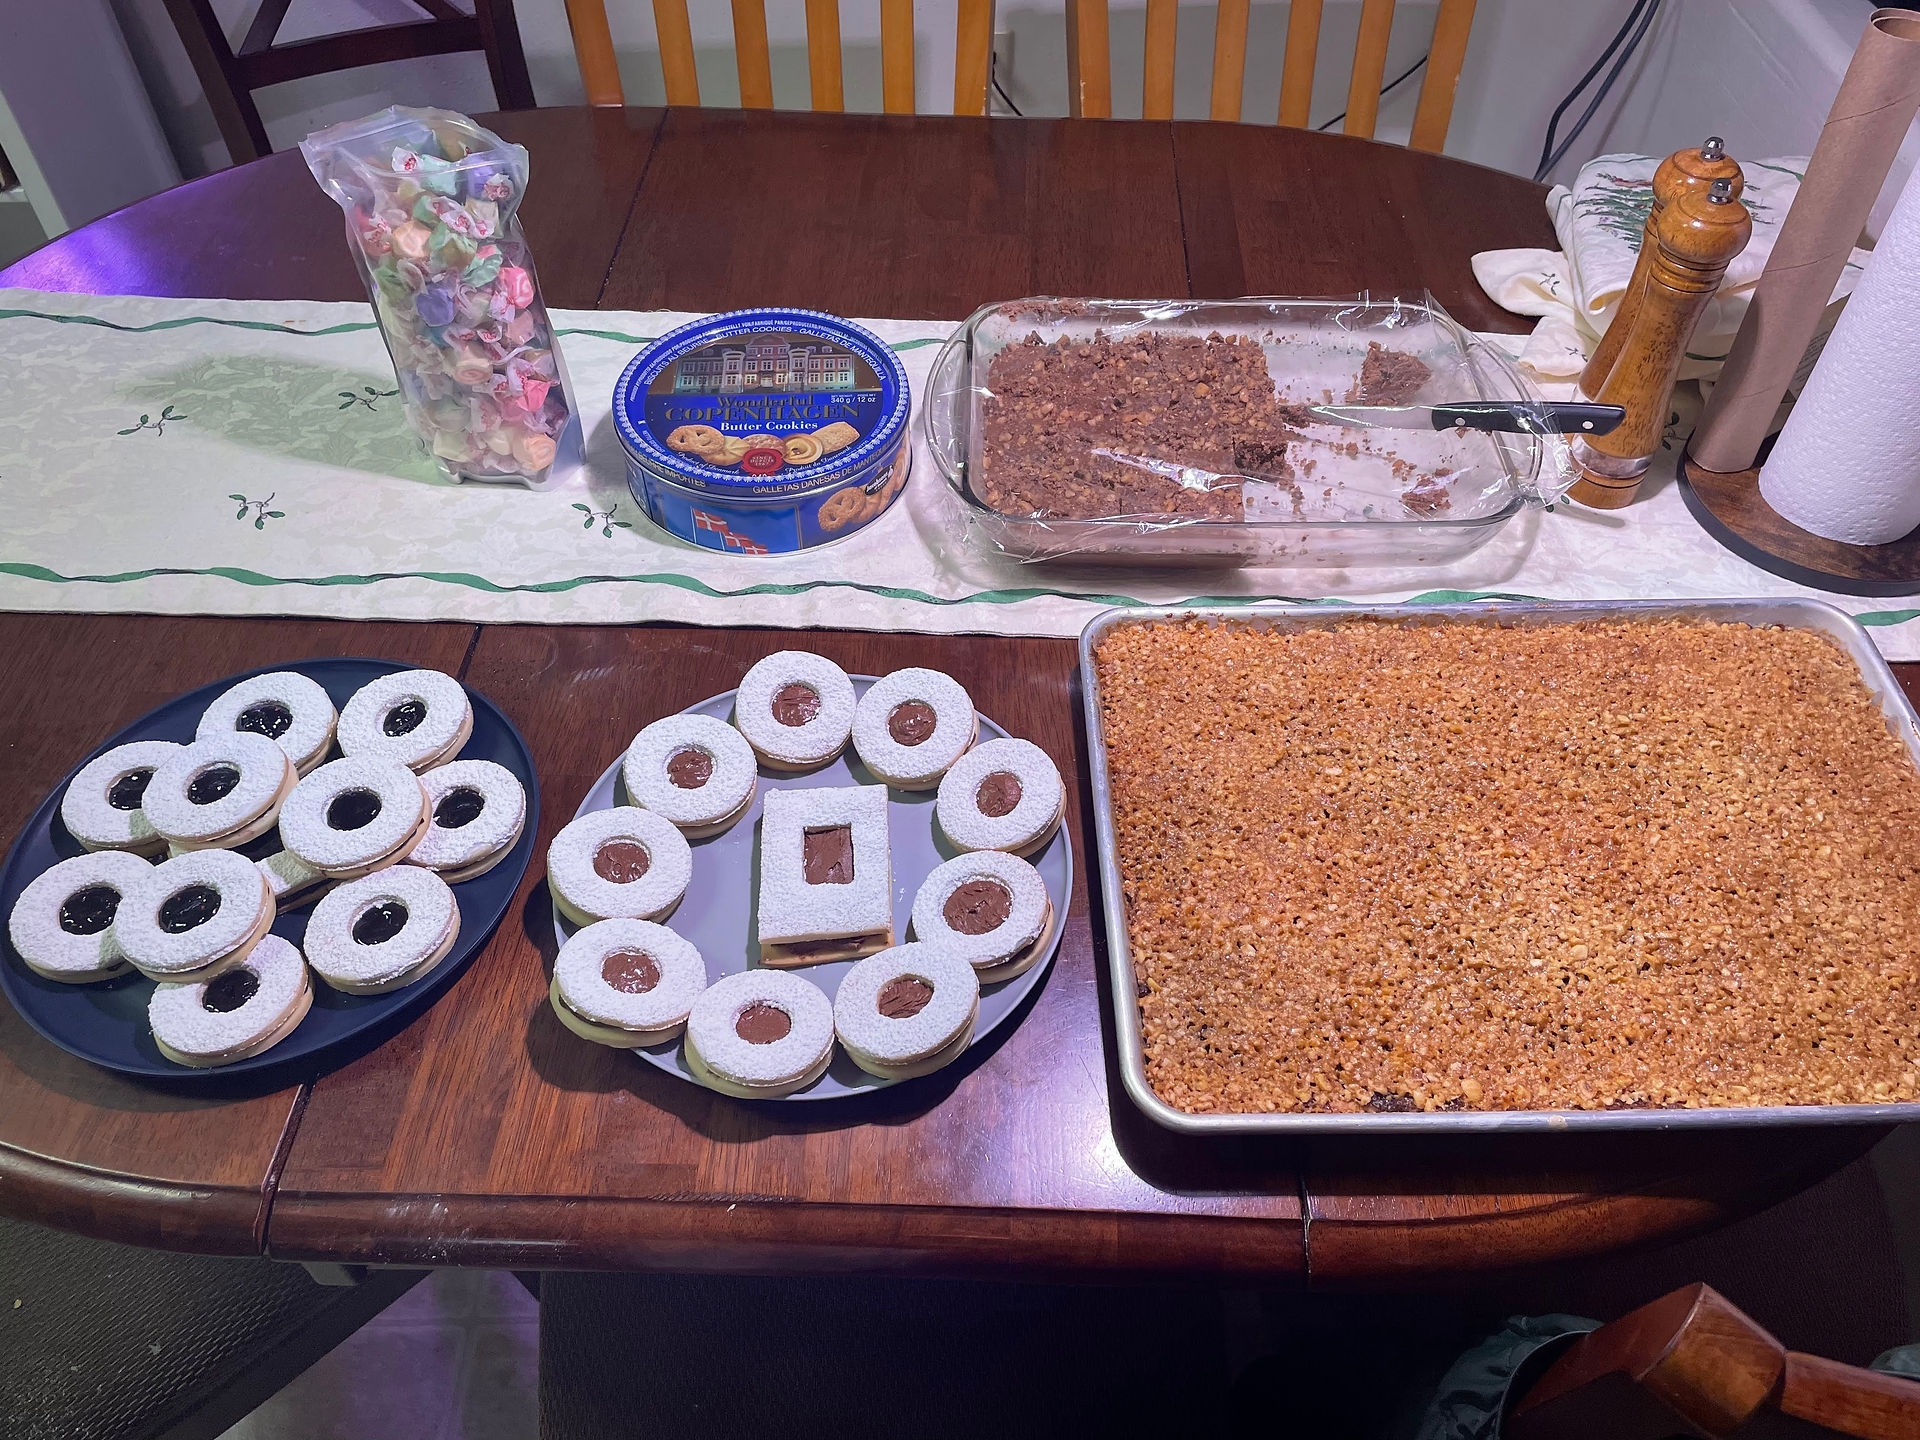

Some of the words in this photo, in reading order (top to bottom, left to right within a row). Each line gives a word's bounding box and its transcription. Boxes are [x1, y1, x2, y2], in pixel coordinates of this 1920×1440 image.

[715, 328, 751, 340] BUTTER
[799, 328, 840, 343] GALLETAS
[839, 340, 852, 350] DE
[850, 345, 888, 382] MANTEQUILLA
[717, 395, 814, 408] Wonderful
[665, 404, 861, 422] COPENHAGEN
[720, 422, 763, 431] Butter
[765, 421, 818, 431] Cookies
[752, 483, 800, 495] GALLETAS
[800, 472, 842, 489] DANESAS
[841, 466, 853, 477] DE
